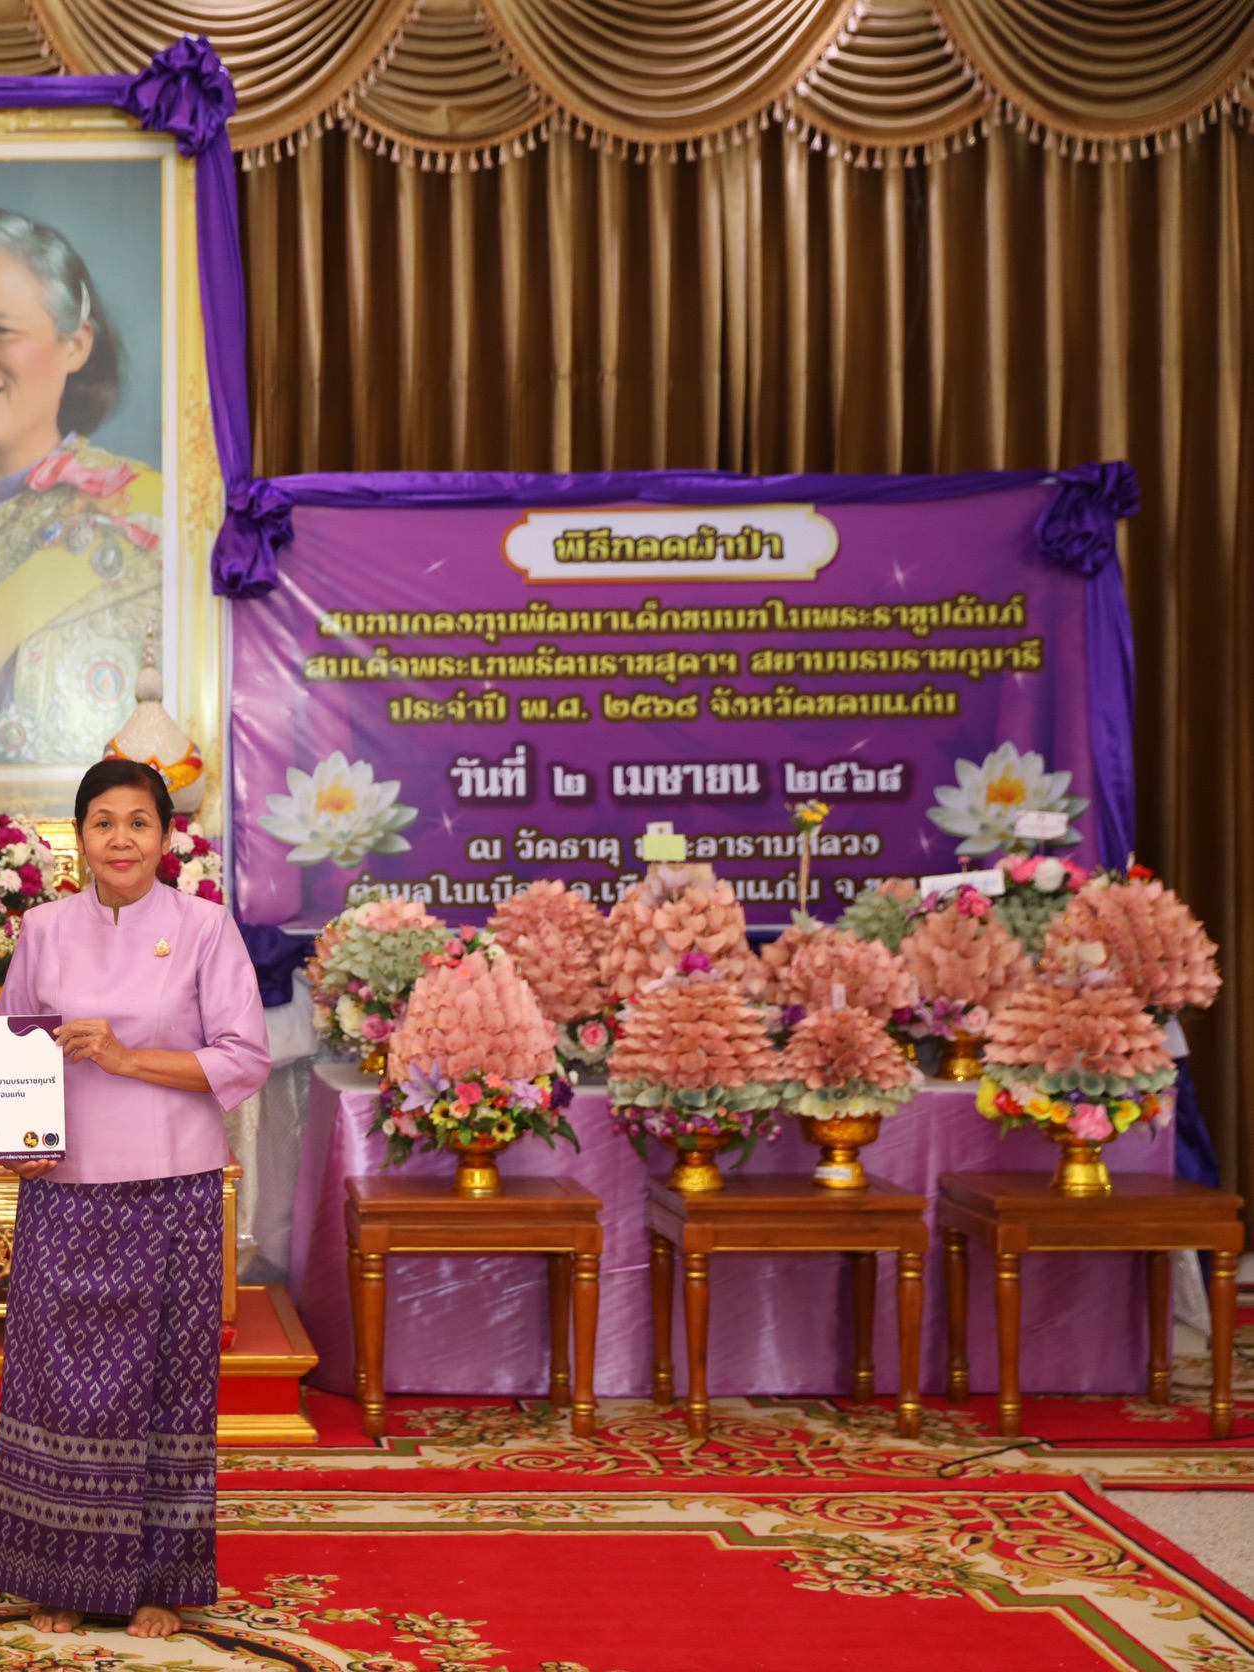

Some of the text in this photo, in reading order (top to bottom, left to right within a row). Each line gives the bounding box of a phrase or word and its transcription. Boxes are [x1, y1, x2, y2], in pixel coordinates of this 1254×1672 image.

[554, 526, 784, 562] พิธีทอดผ้าป่า
[750, 639, 1042, 681] สยามบรมราชกุมารี
[389, 685, 958, 721] ประจำปี พ.ศ. ๒๕๖๘ จังหวัดขอนแก่น
[450, 745, 904, 797] วันที่ ๒ เมษายน ๒๕๖๘
[468, 828, 882, 867] ณ วัดธาตุ ะอารามหลวง
